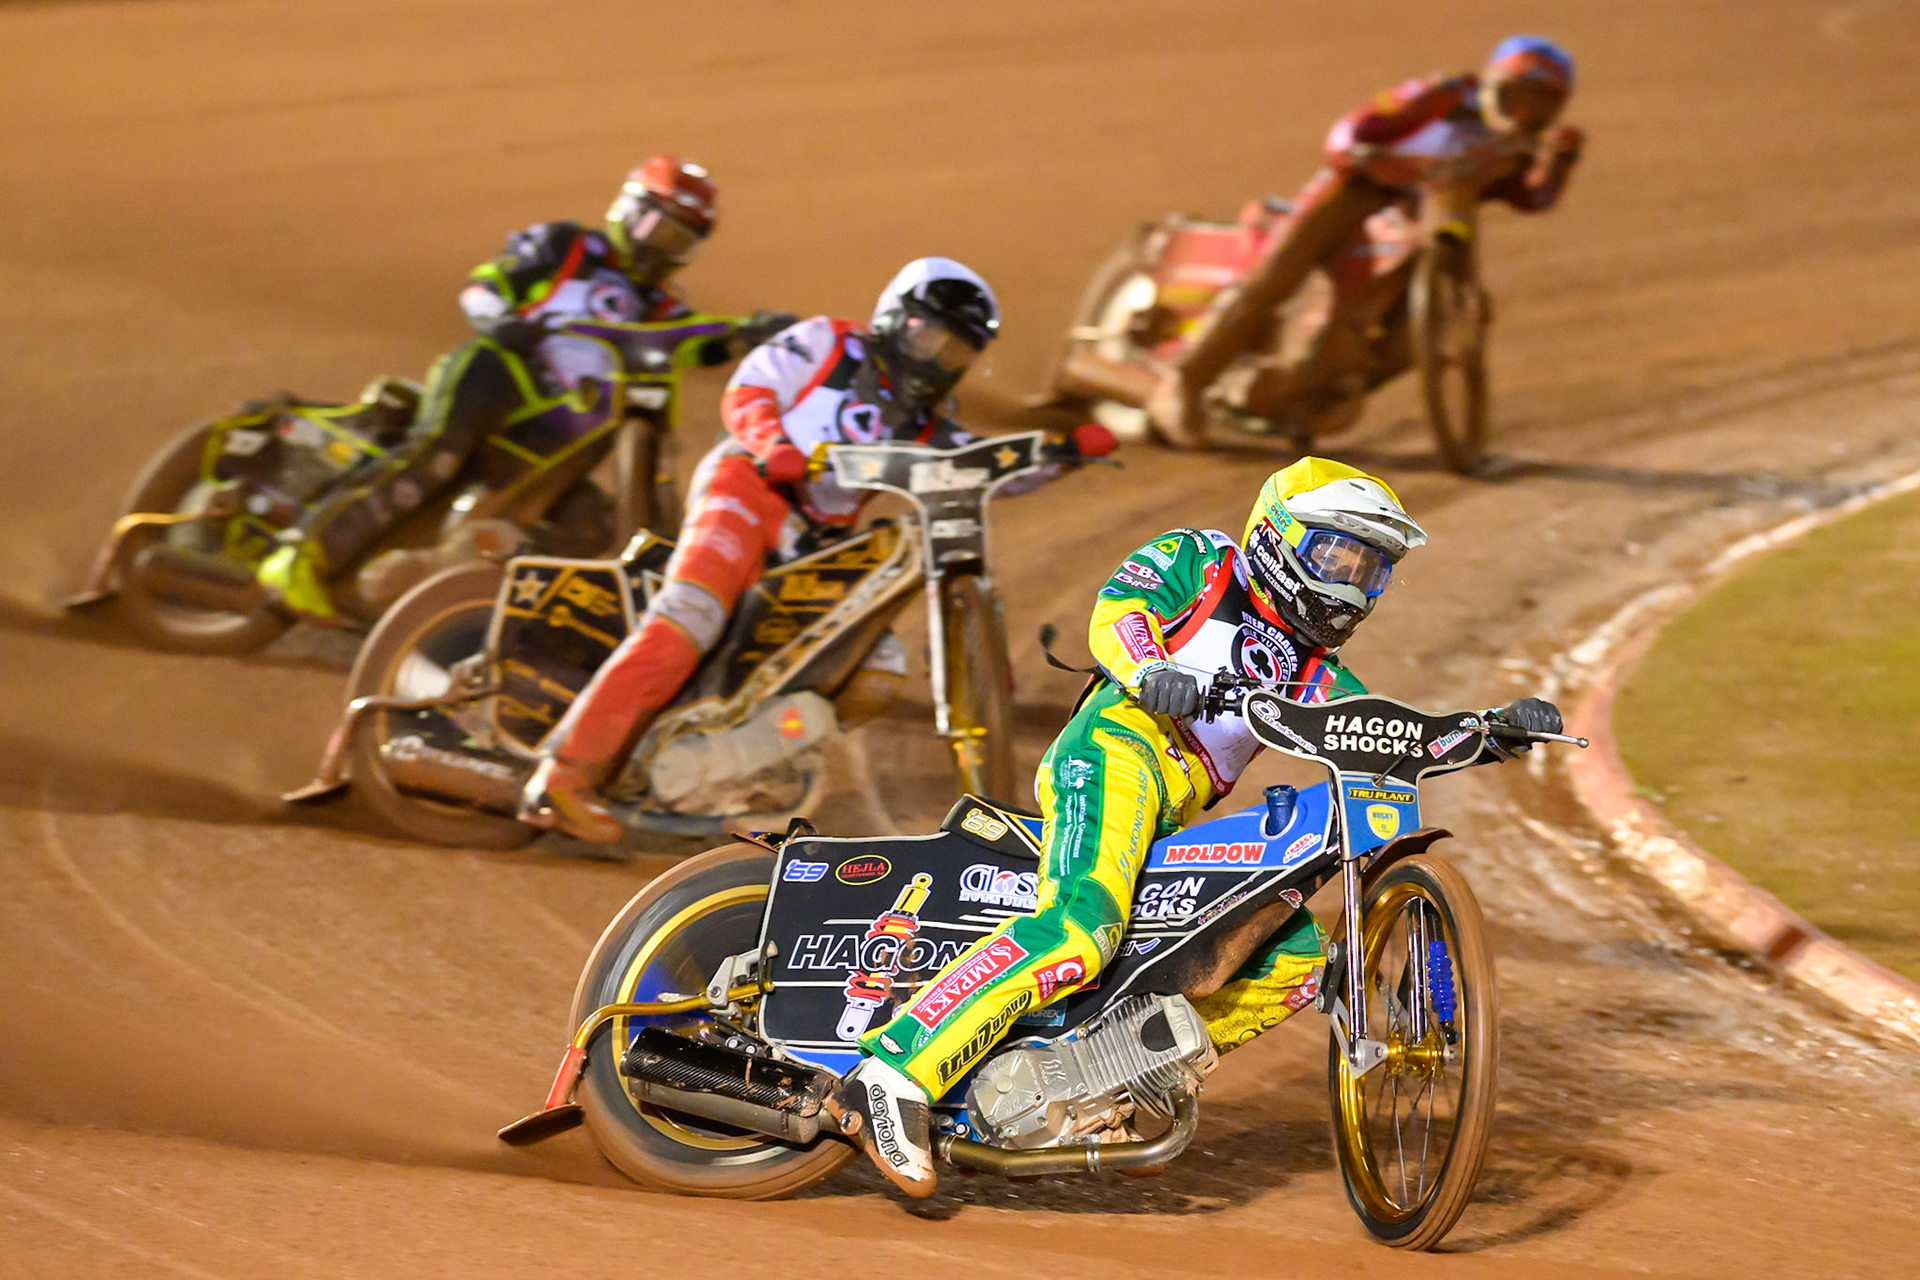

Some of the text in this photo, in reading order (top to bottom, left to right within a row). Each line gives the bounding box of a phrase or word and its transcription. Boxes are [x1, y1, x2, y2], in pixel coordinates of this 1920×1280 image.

[1271, 505, 1289, 528] OAKLEY
[1256, 545, 1301, 595] cellfast
[1264, 572, 1294, 602] ACCESSORIES
[1241, 611, 1298, 673] PETER CRAVEN
[1260, 635, 1279, 654] VUE
[1277, 655, 1288, 681] ACES
[1286, 730, 1307, 747] Services
[1325, 715, 1423, 740] HAGON
[1324, 734, 1424, 758] SHOCKS
[1351, 789, 1412, 802] TRU PLANT
[1128, 768, 1148, 857] KRONO-PLAST
[1073, 822, 1087, 858] Government
[1165, 845, 1264, 863] MOLDOW
[842, 861, 885, 874] HEJLA
[961, 866, 1038, 894] Glos
[962, 891, 999, 902] HUTA
[1139, 877, 1206, 902] GON
[788, 935, 973, 971] HAGON
[942, 950, 988, 987] PRODUCENT
[927, 957, 1000, 1022] IMPAKT
[869, 1084, 909, 1167] daytona
